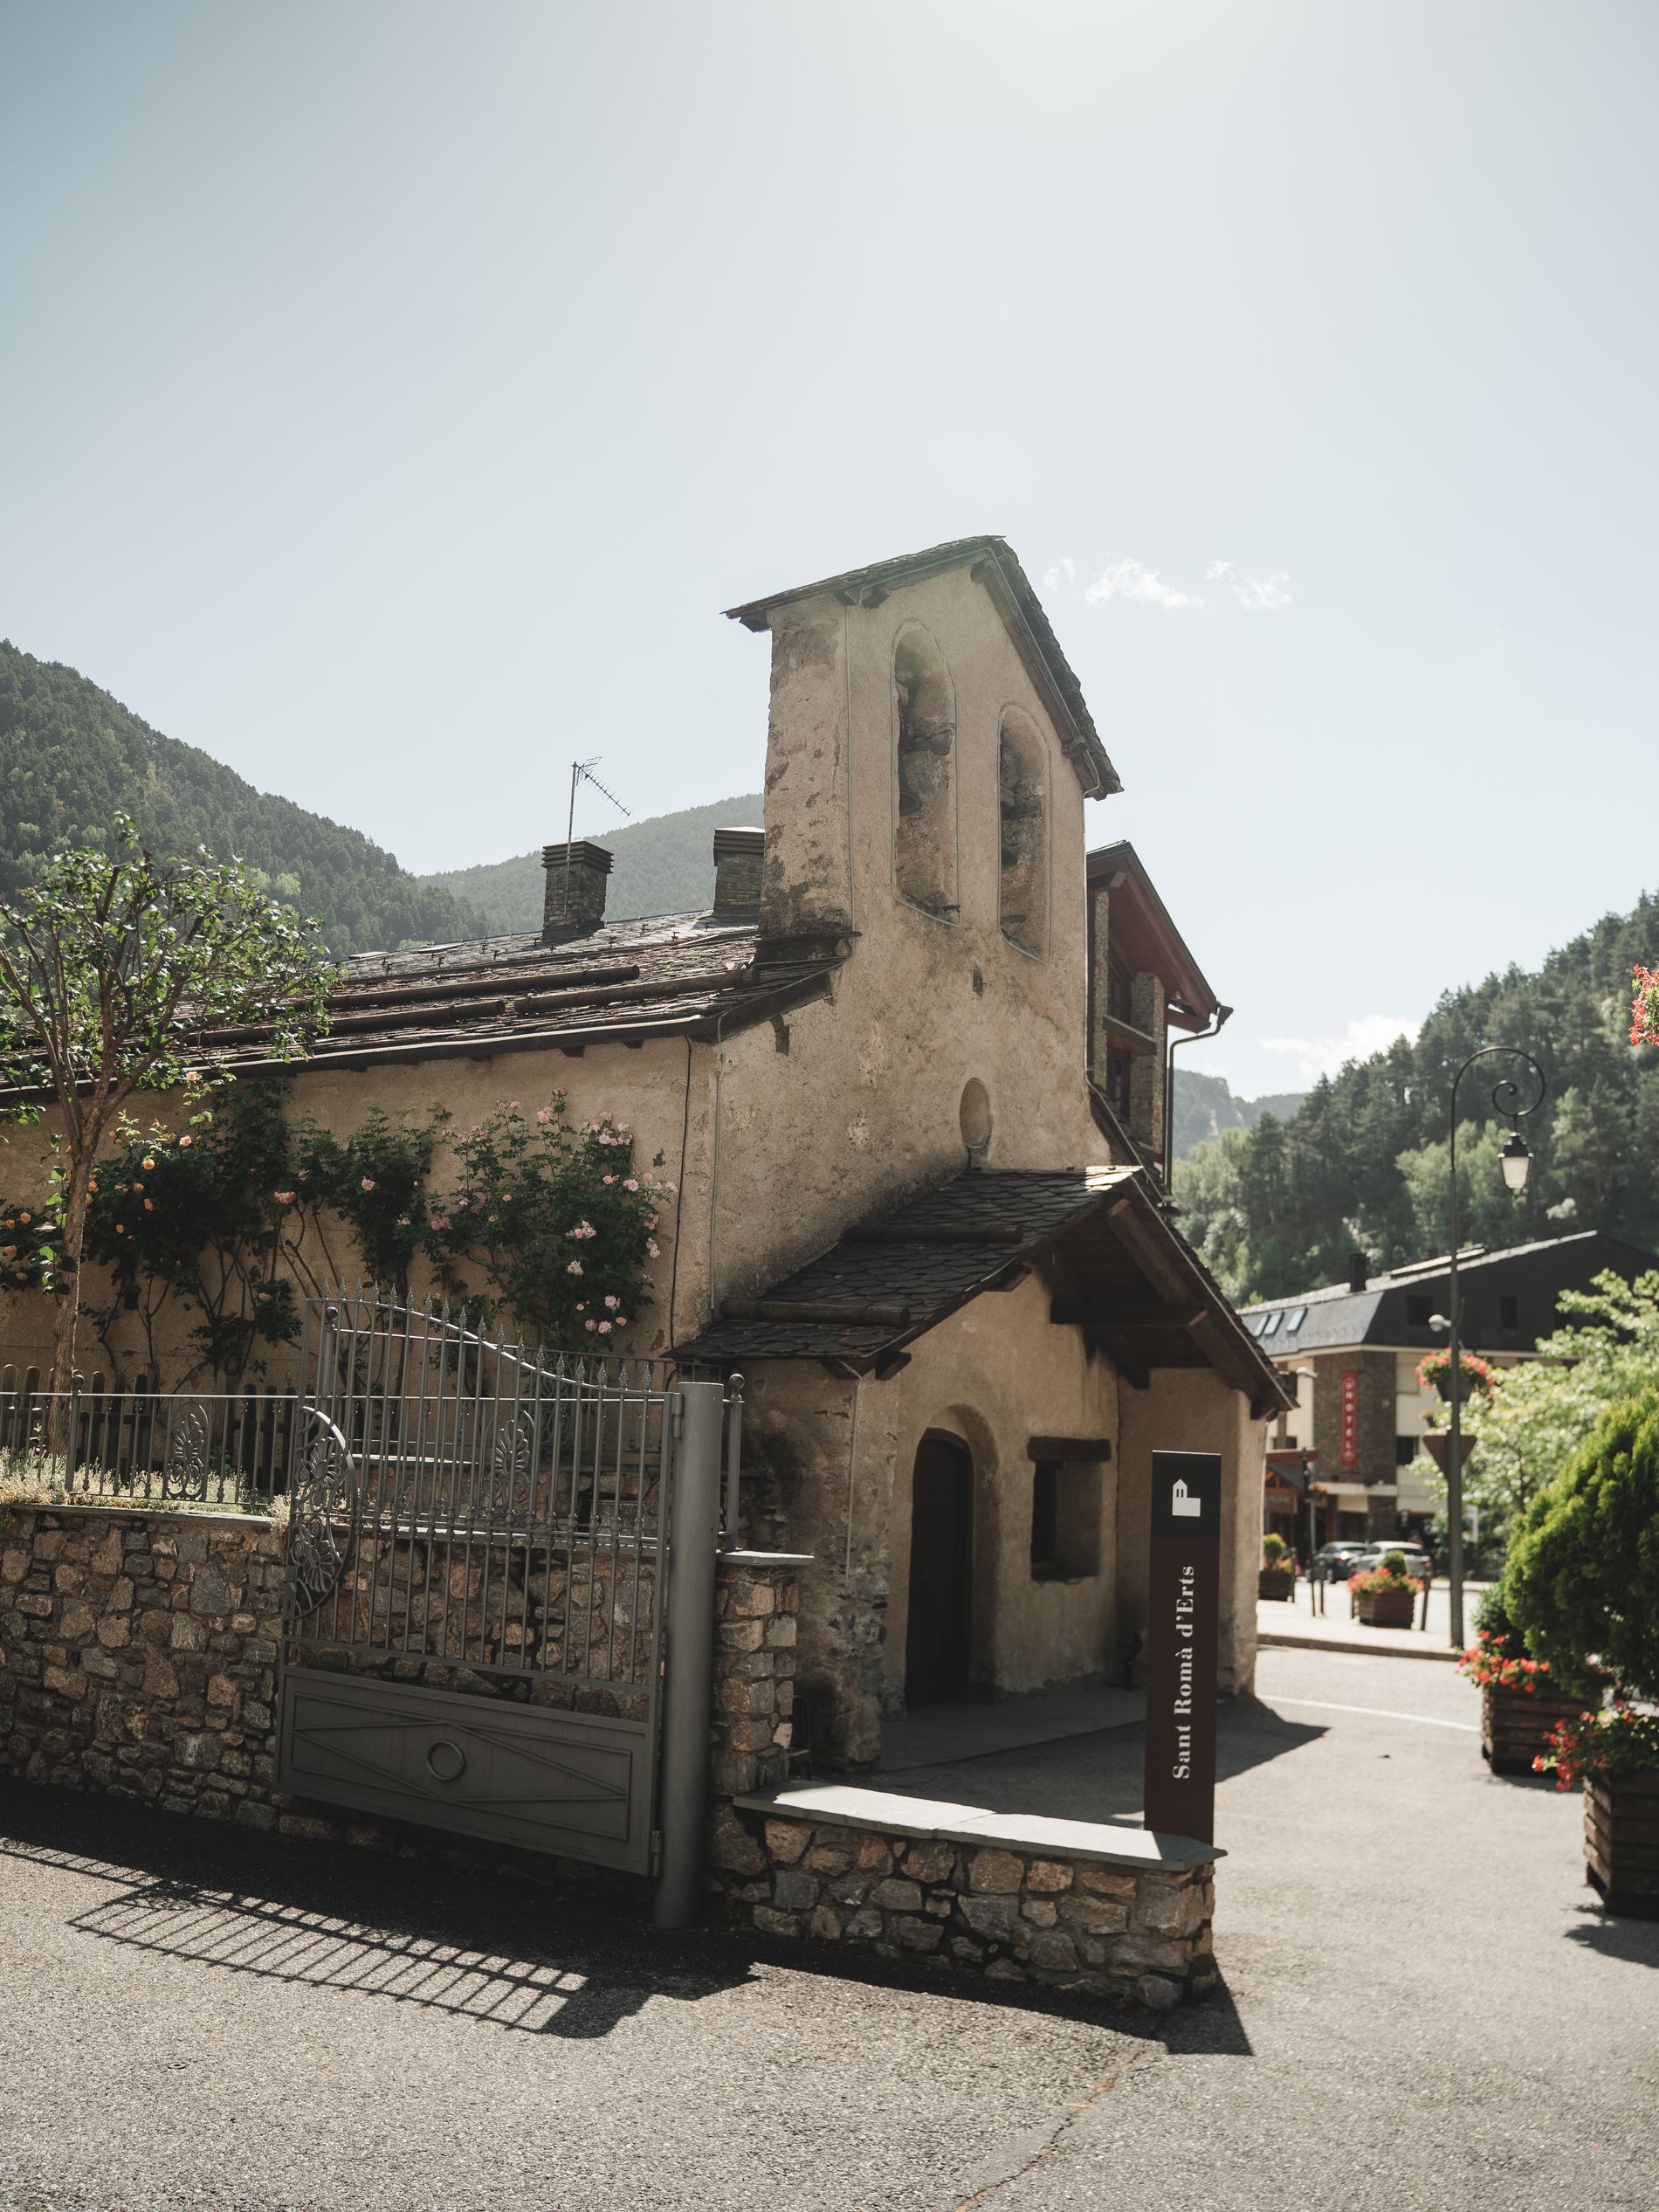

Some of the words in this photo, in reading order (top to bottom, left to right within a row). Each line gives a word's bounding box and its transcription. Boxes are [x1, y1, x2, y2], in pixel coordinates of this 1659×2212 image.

[1345, 1391, 1353, 1450] HOTEL
[1175, 1566, 1194, 1638] d’Erts
[1174, 1647, 1193, 1714] Romà
[1173, 1725, 1191, 1779] Sant
